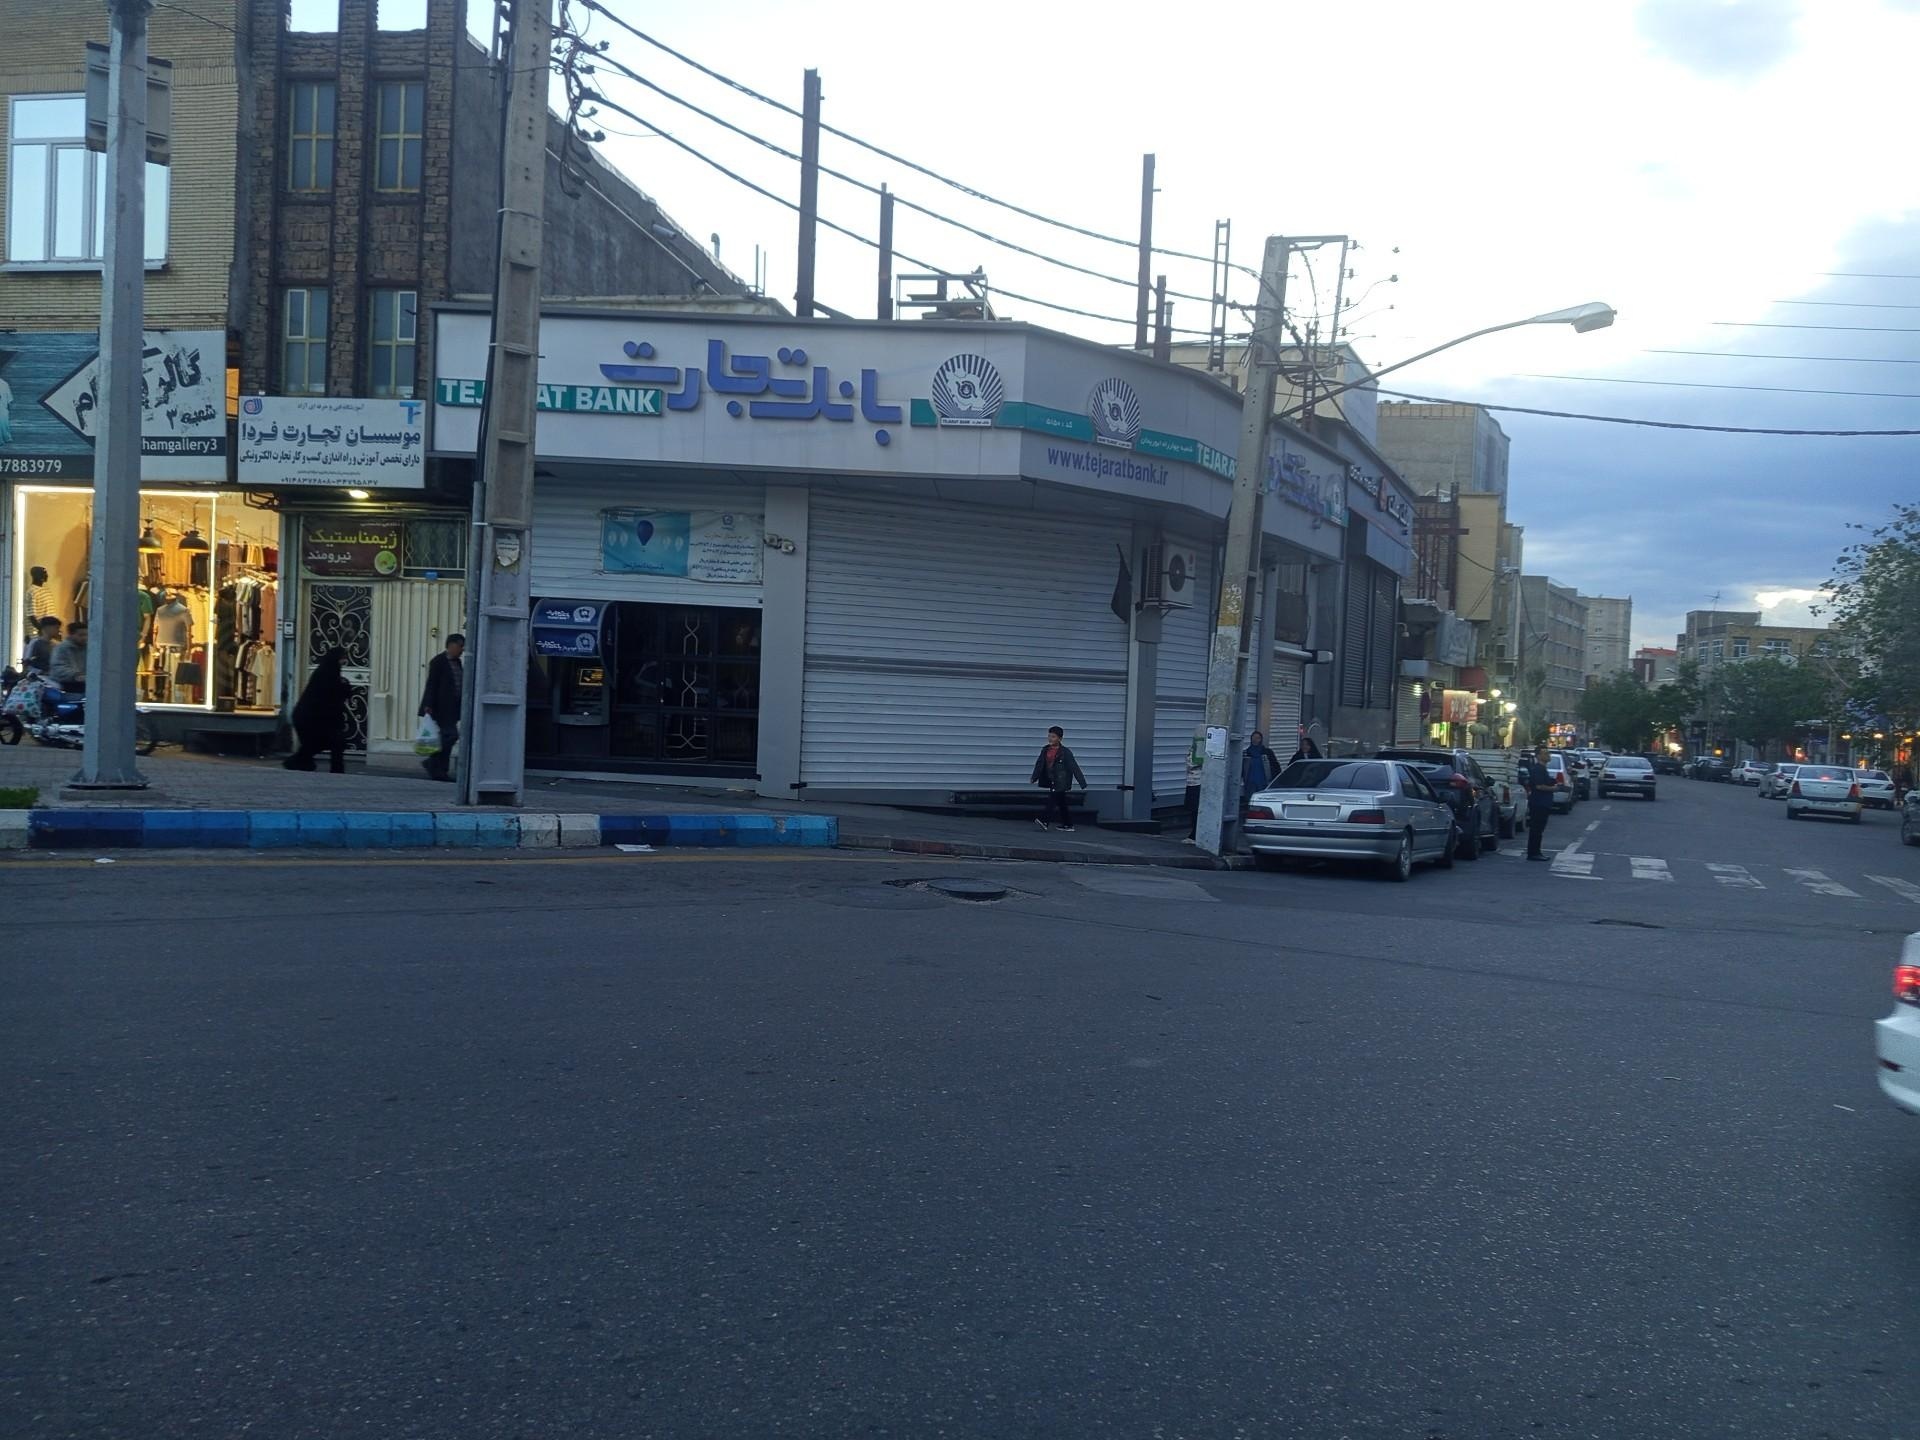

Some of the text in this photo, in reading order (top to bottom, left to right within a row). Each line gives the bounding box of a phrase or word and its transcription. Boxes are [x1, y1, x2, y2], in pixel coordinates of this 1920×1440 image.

[439, 379, 656, 413] TEAT BANK
[599, 339, 902, 446] بانک تجارت
[166, 404, 216, 429] شعبه ۳
[142, 437, 217, 453] hamgallery3
[242, 420, 421, 449] موسسان تجارت فردا
[357, 451, 379, 466] آموزش
[402, 453, 420, 467] دارای
[1047, 448, 1169, 486] www.tejaratbank.ir
[1196, 441, 1237, 480] TEJARA
[308, 529, 397, 549] ژیمناستیک
[307, 550, 352, 563] نیرومند
